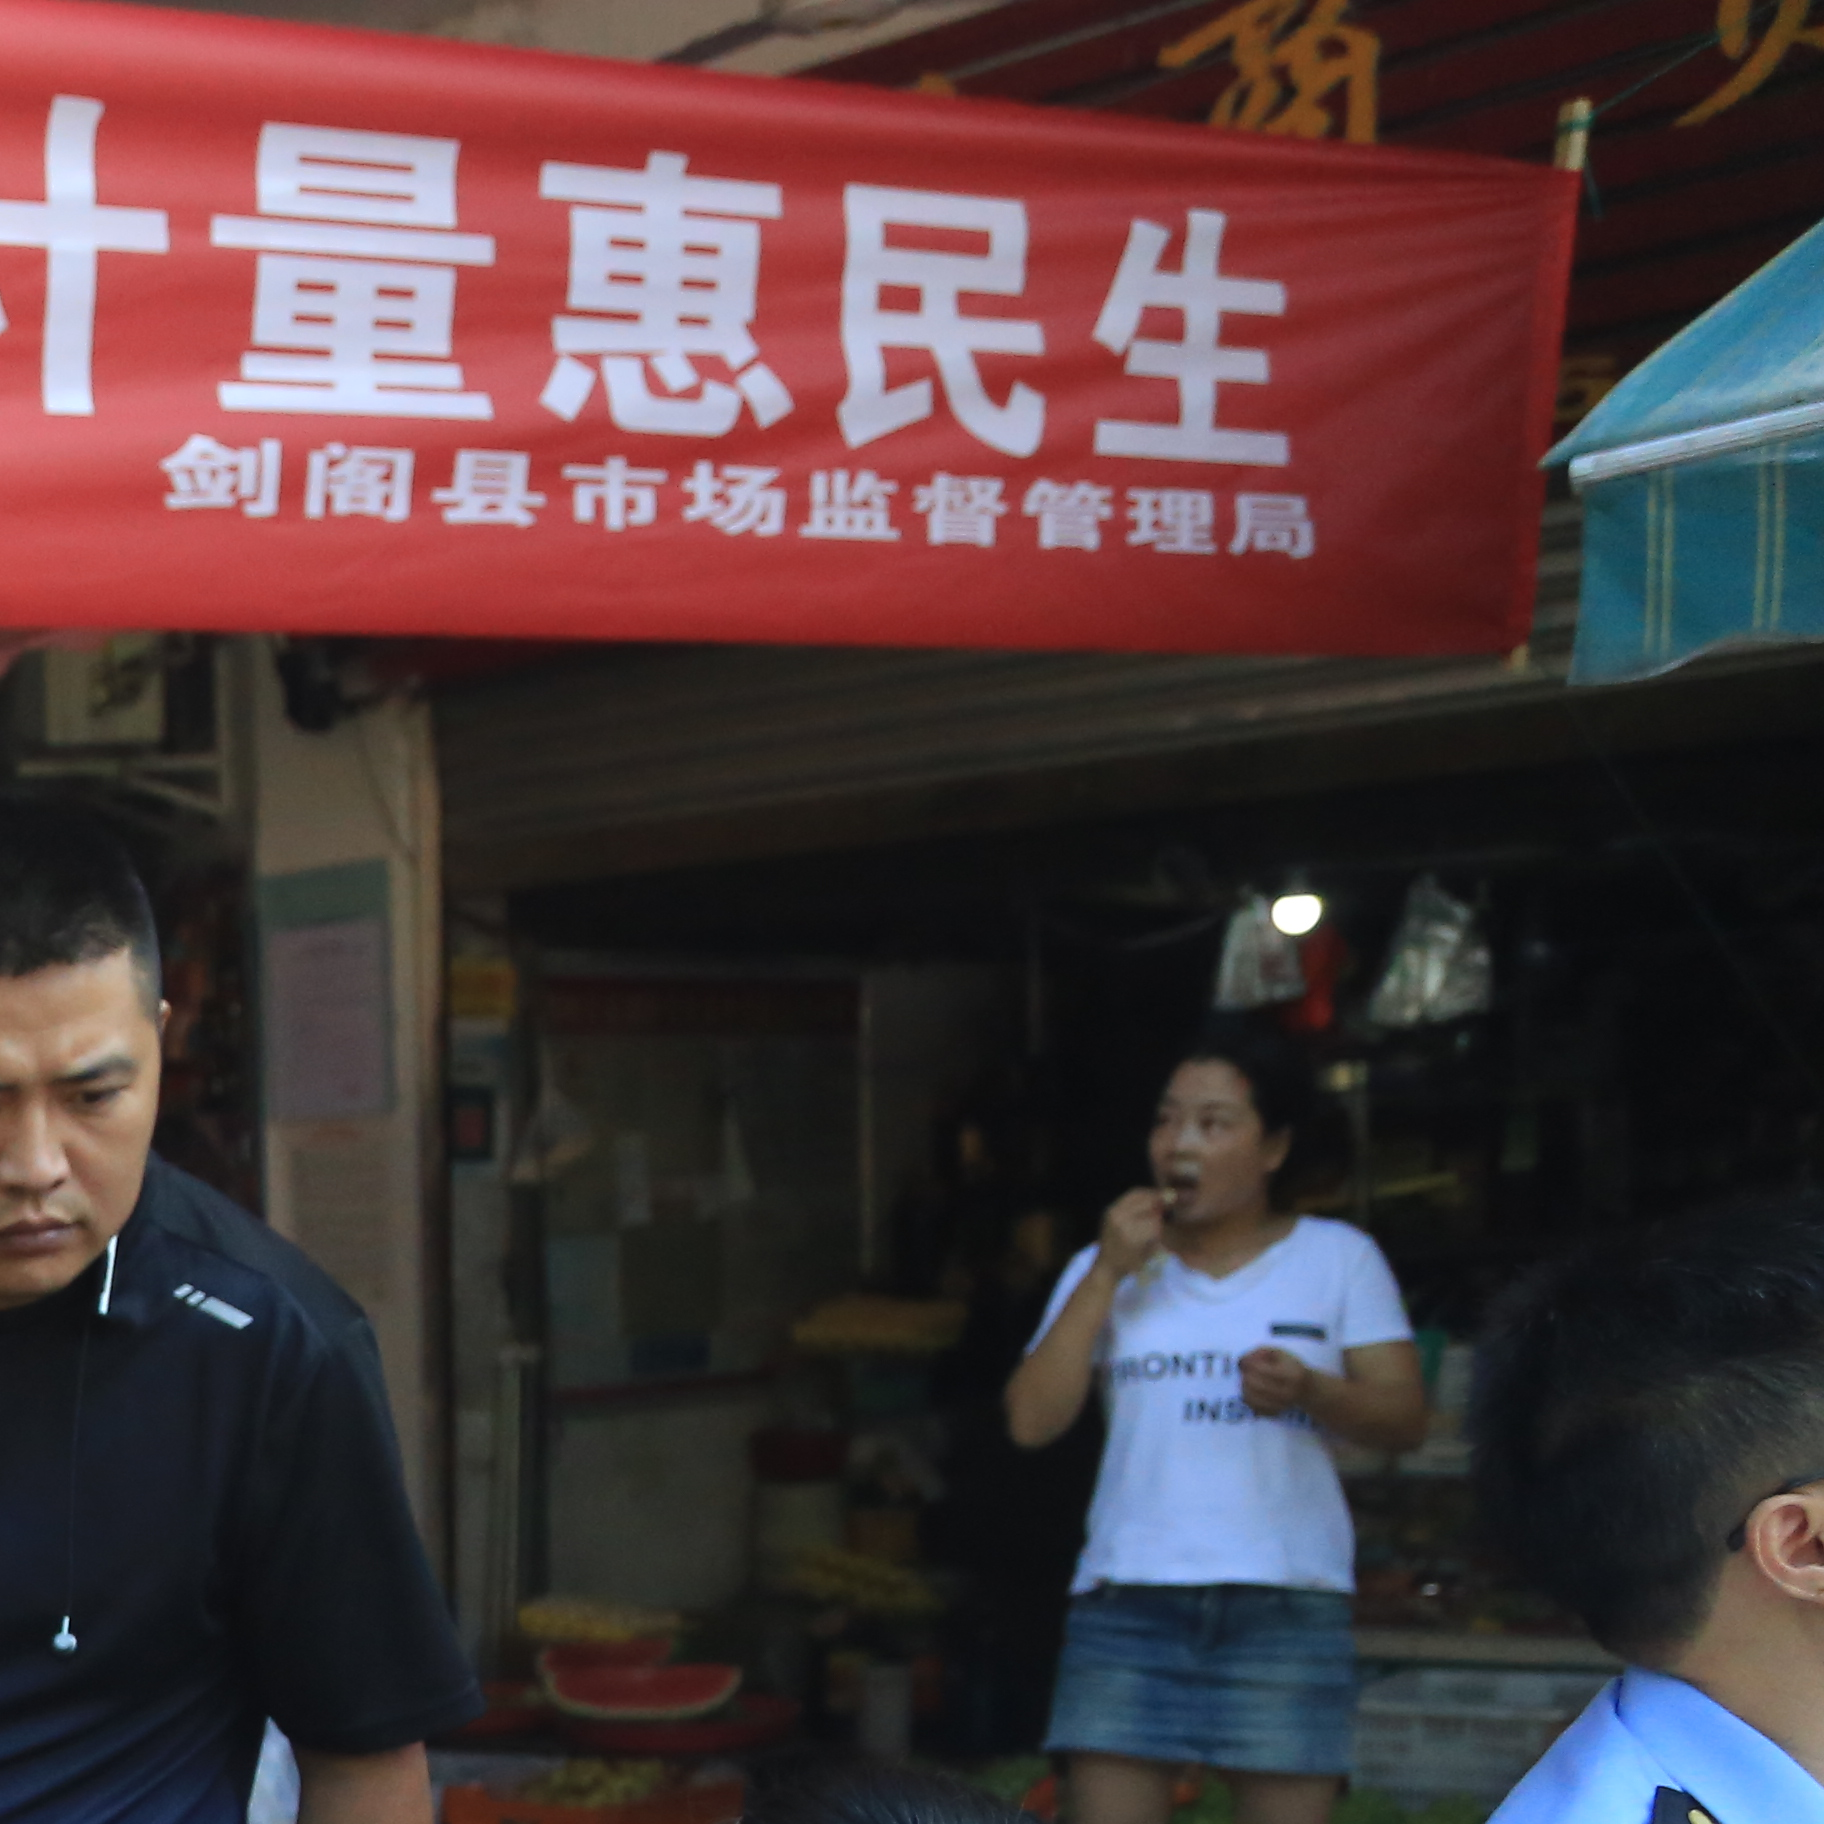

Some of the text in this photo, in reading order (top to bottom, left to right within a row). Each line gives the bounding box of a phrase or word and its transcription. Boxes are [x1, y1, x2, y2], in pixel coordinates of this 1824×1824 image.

[161, 434, 1318, 563] 剑阁县市场监督管理局
